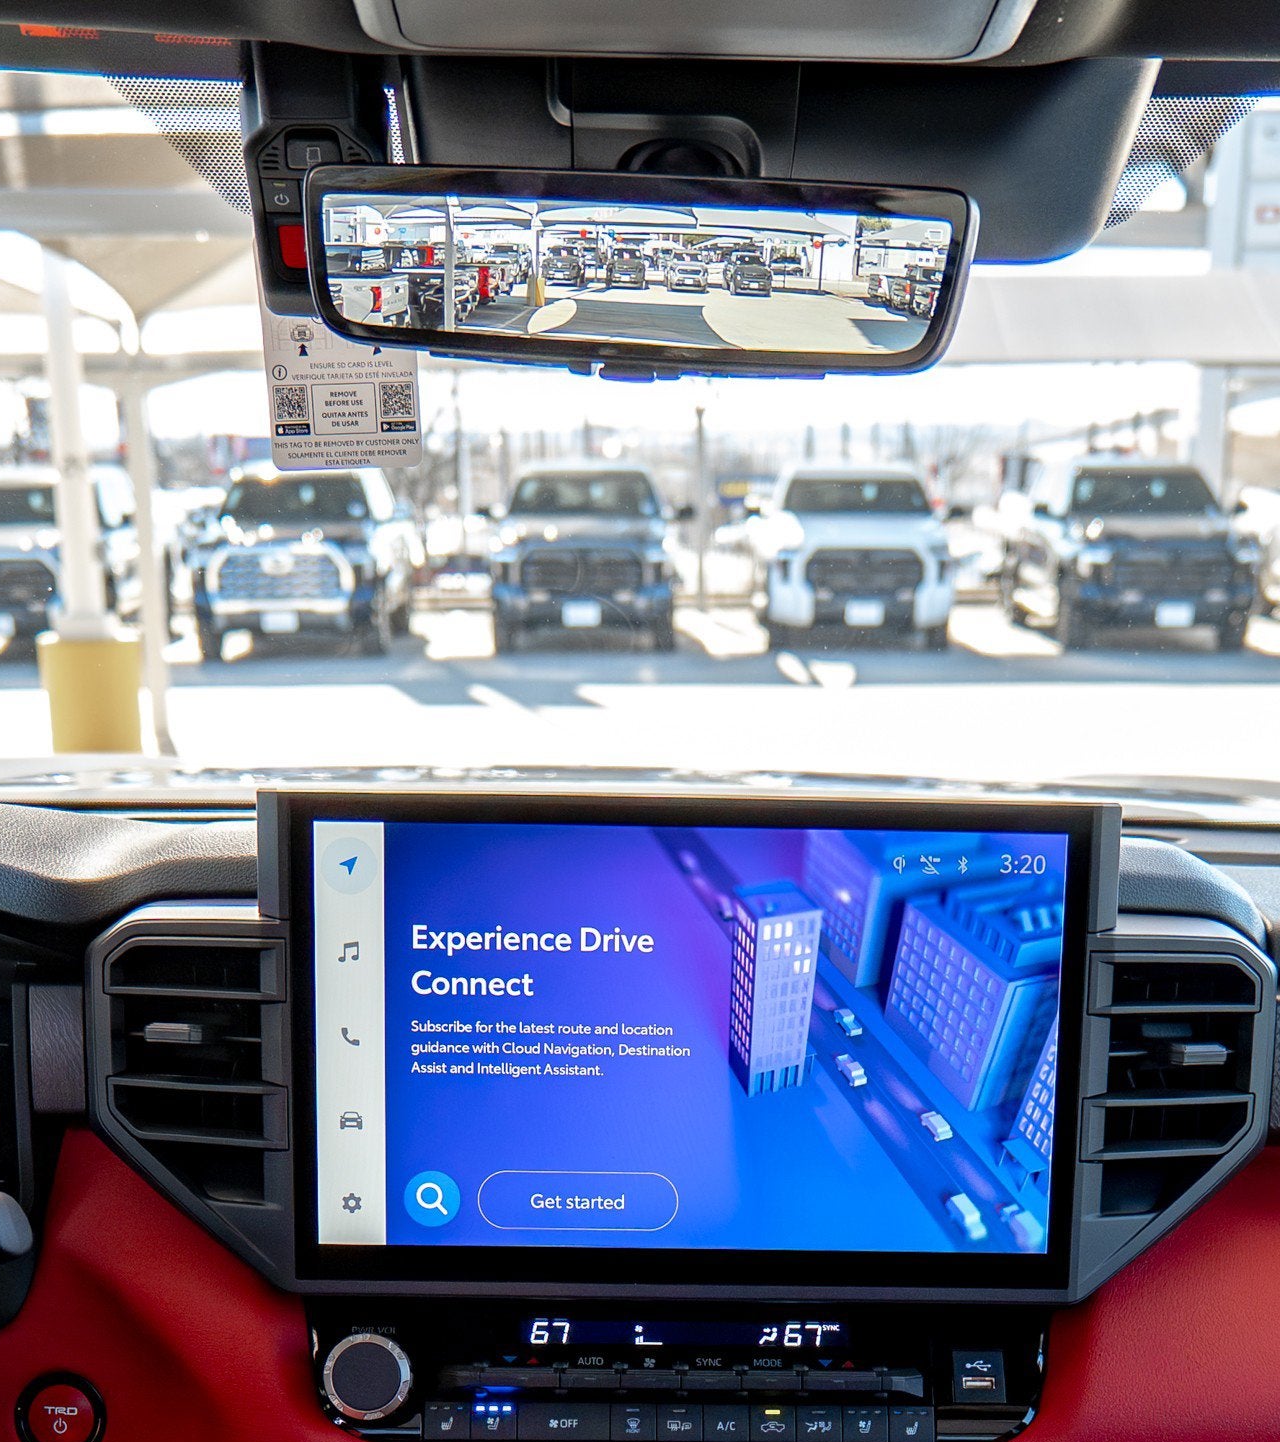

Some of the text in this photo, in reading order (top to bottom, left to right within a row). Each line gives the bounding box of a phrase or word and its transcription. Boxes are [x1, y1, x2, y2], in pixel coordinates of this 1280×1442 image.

[310, 362, 335, 370] ENSURE
[347, 361, 366, 369] CARD
[322, 411, 347, 419] QUITAR
[289, 441, 303, 449] TAG
[288, 451, 325, 459] SOLAMENTE
[999, 853, 1047, 875] 3:20
[411, 924, 655, 956] Experience Drive
[410, 970, 534, 997] Connect
[410, 1020, 673, 1036] Subscribe for the latest route and location
[410, 1041, 691, 1058] guidance with Cloud Navigation, Destination
[410, 1062, 604, 1077] Assist and Intelligent Assistant.
[530, 1193, 625, 1210] Get started
[351, 1325, 397, 1334] PWR VOL
[530, 1321, 570, 1344] 67
[822, 1324, 840, 1332] SYNC
[783, 1324, 822, 1347] 67
[577, 1356, 604, 1366] AUTO
[695, 1358, 722, 1367] SYNC
[753, 1358, 782, 1368] MODE
[43, 1405, 78, 1416] TRD
[560, 1419, 578, 1428] OFF
[716, 1421, 736, 1431] A/C
